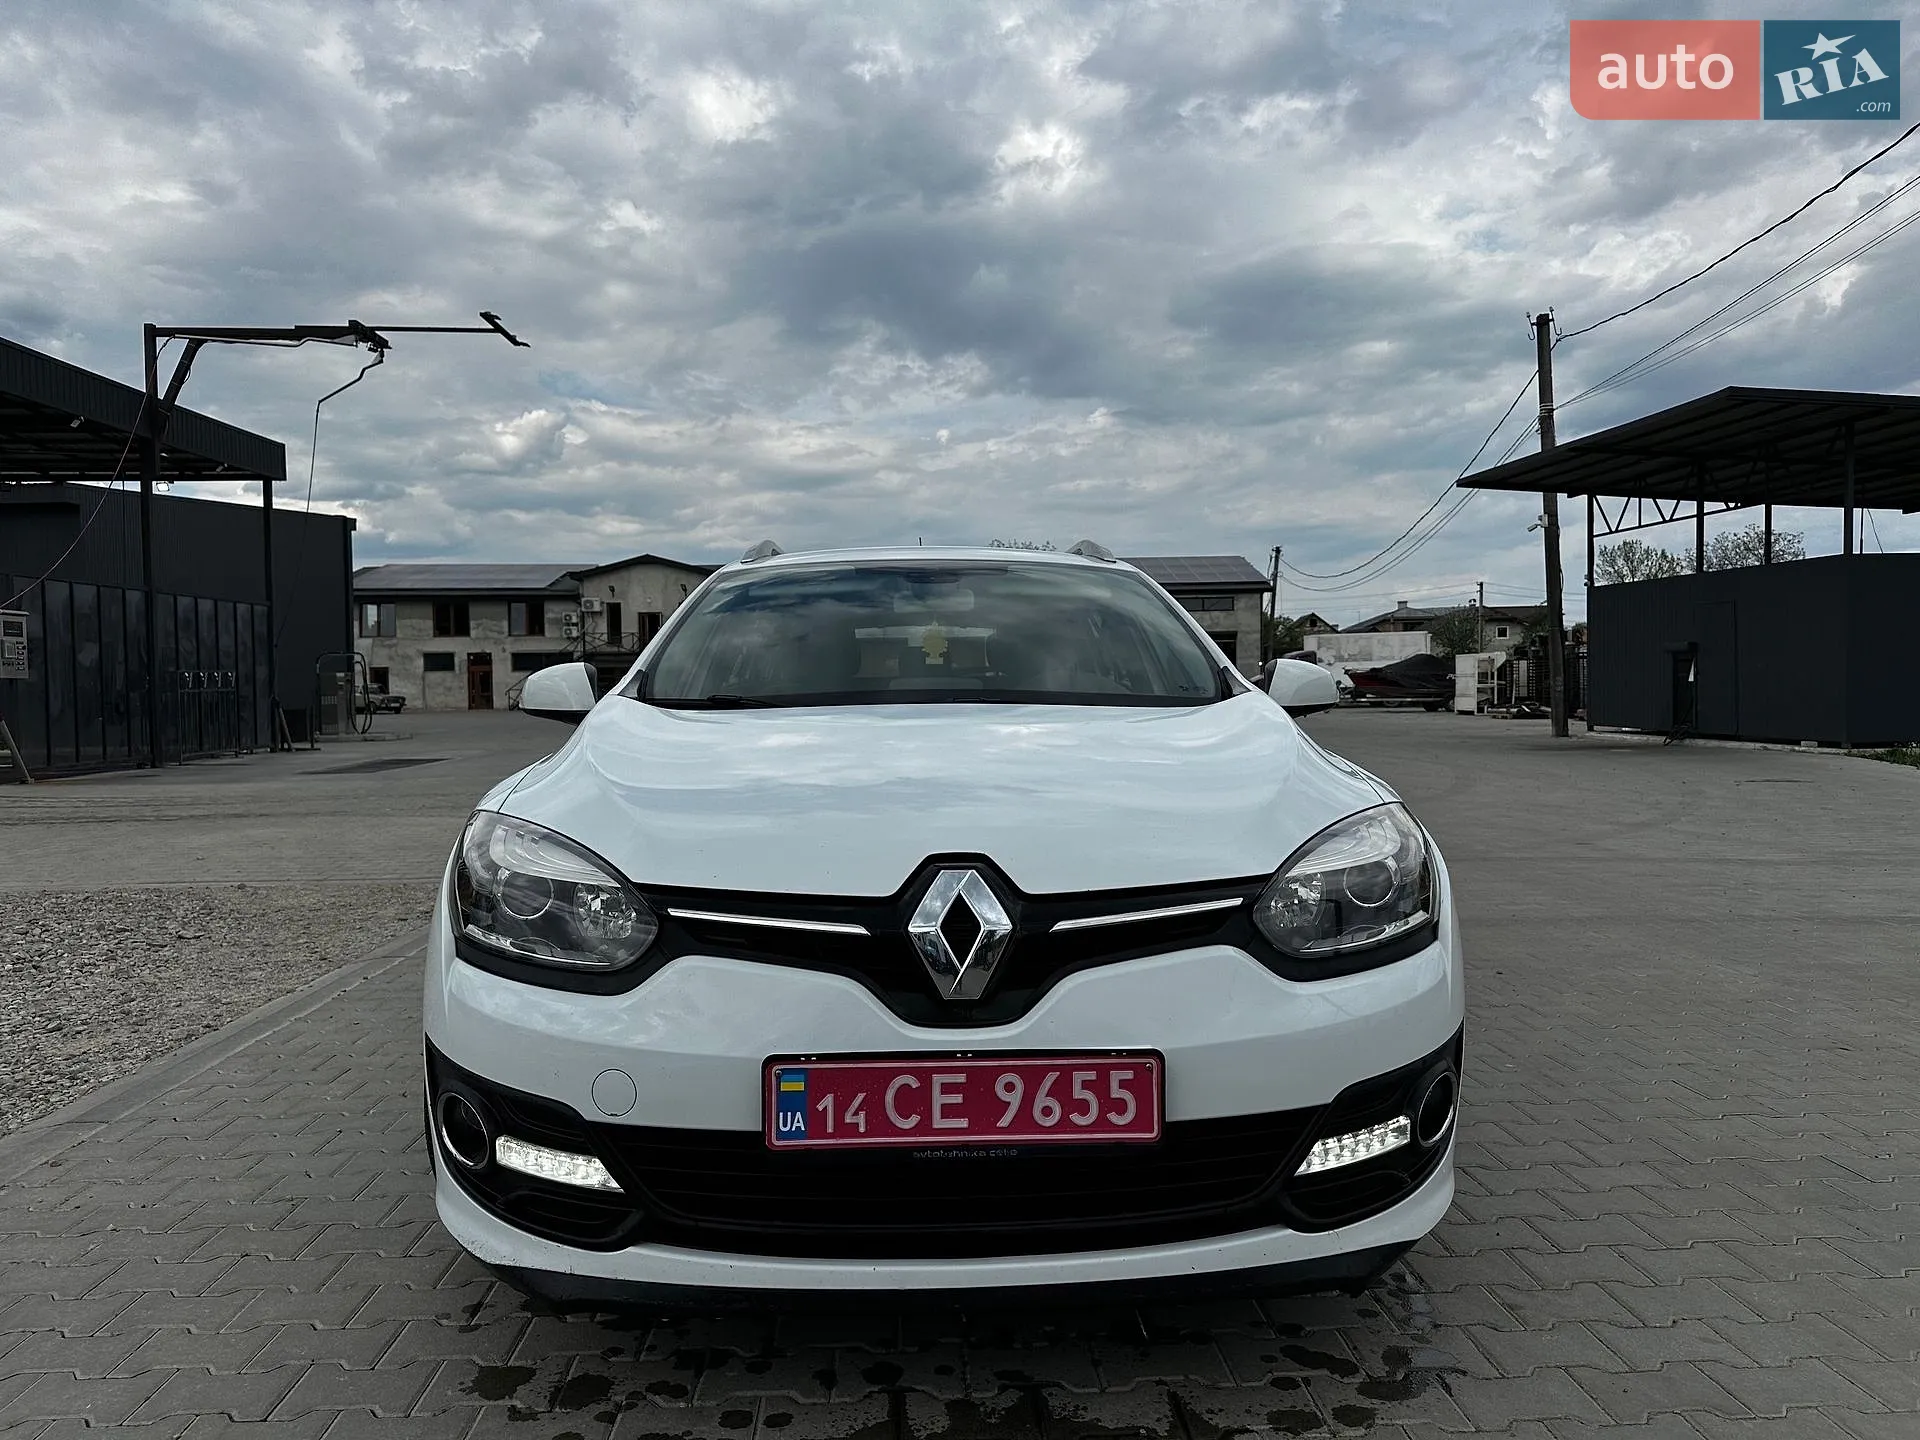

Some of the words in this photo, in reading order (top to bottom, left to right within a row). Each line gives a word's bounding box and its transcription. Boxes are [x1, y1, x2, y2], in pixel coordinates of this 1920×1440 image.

[778, 1111, 807, 1133] UA
[815, 1092, 868, 1133] 14
[884, 1073, 970, 1131] CE
[994, 1070, 1138, 1127] 9655
